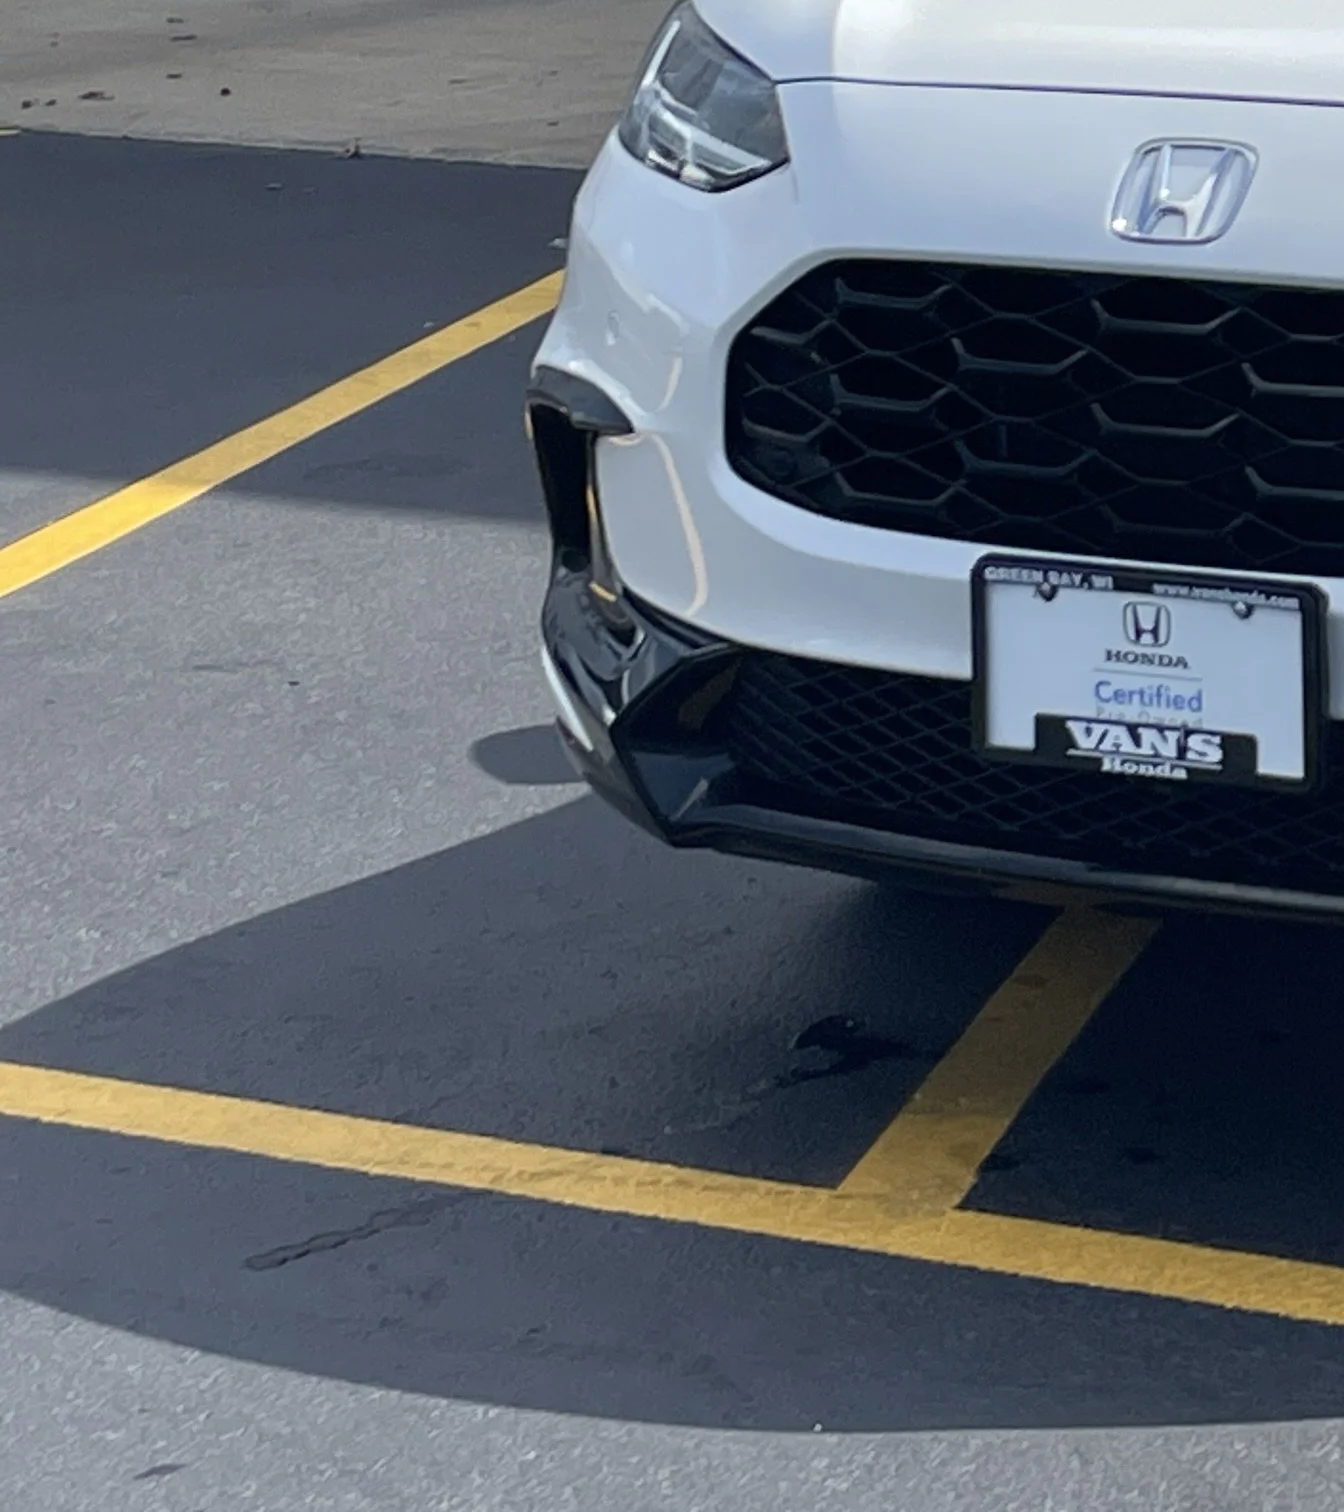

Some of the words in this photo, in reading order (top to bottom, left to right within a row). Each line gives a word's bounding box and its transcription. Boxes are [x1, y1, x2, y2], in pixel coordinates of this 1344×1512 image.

[983, 566, 1045, 585] GREEN
[1104, 648, 1190, 670] HONDA
[1094, 680, 1203, 713] Certified
[1065, 719, 1223, 764] VAN'S
[1100, 755, 1188, 780] Honda
